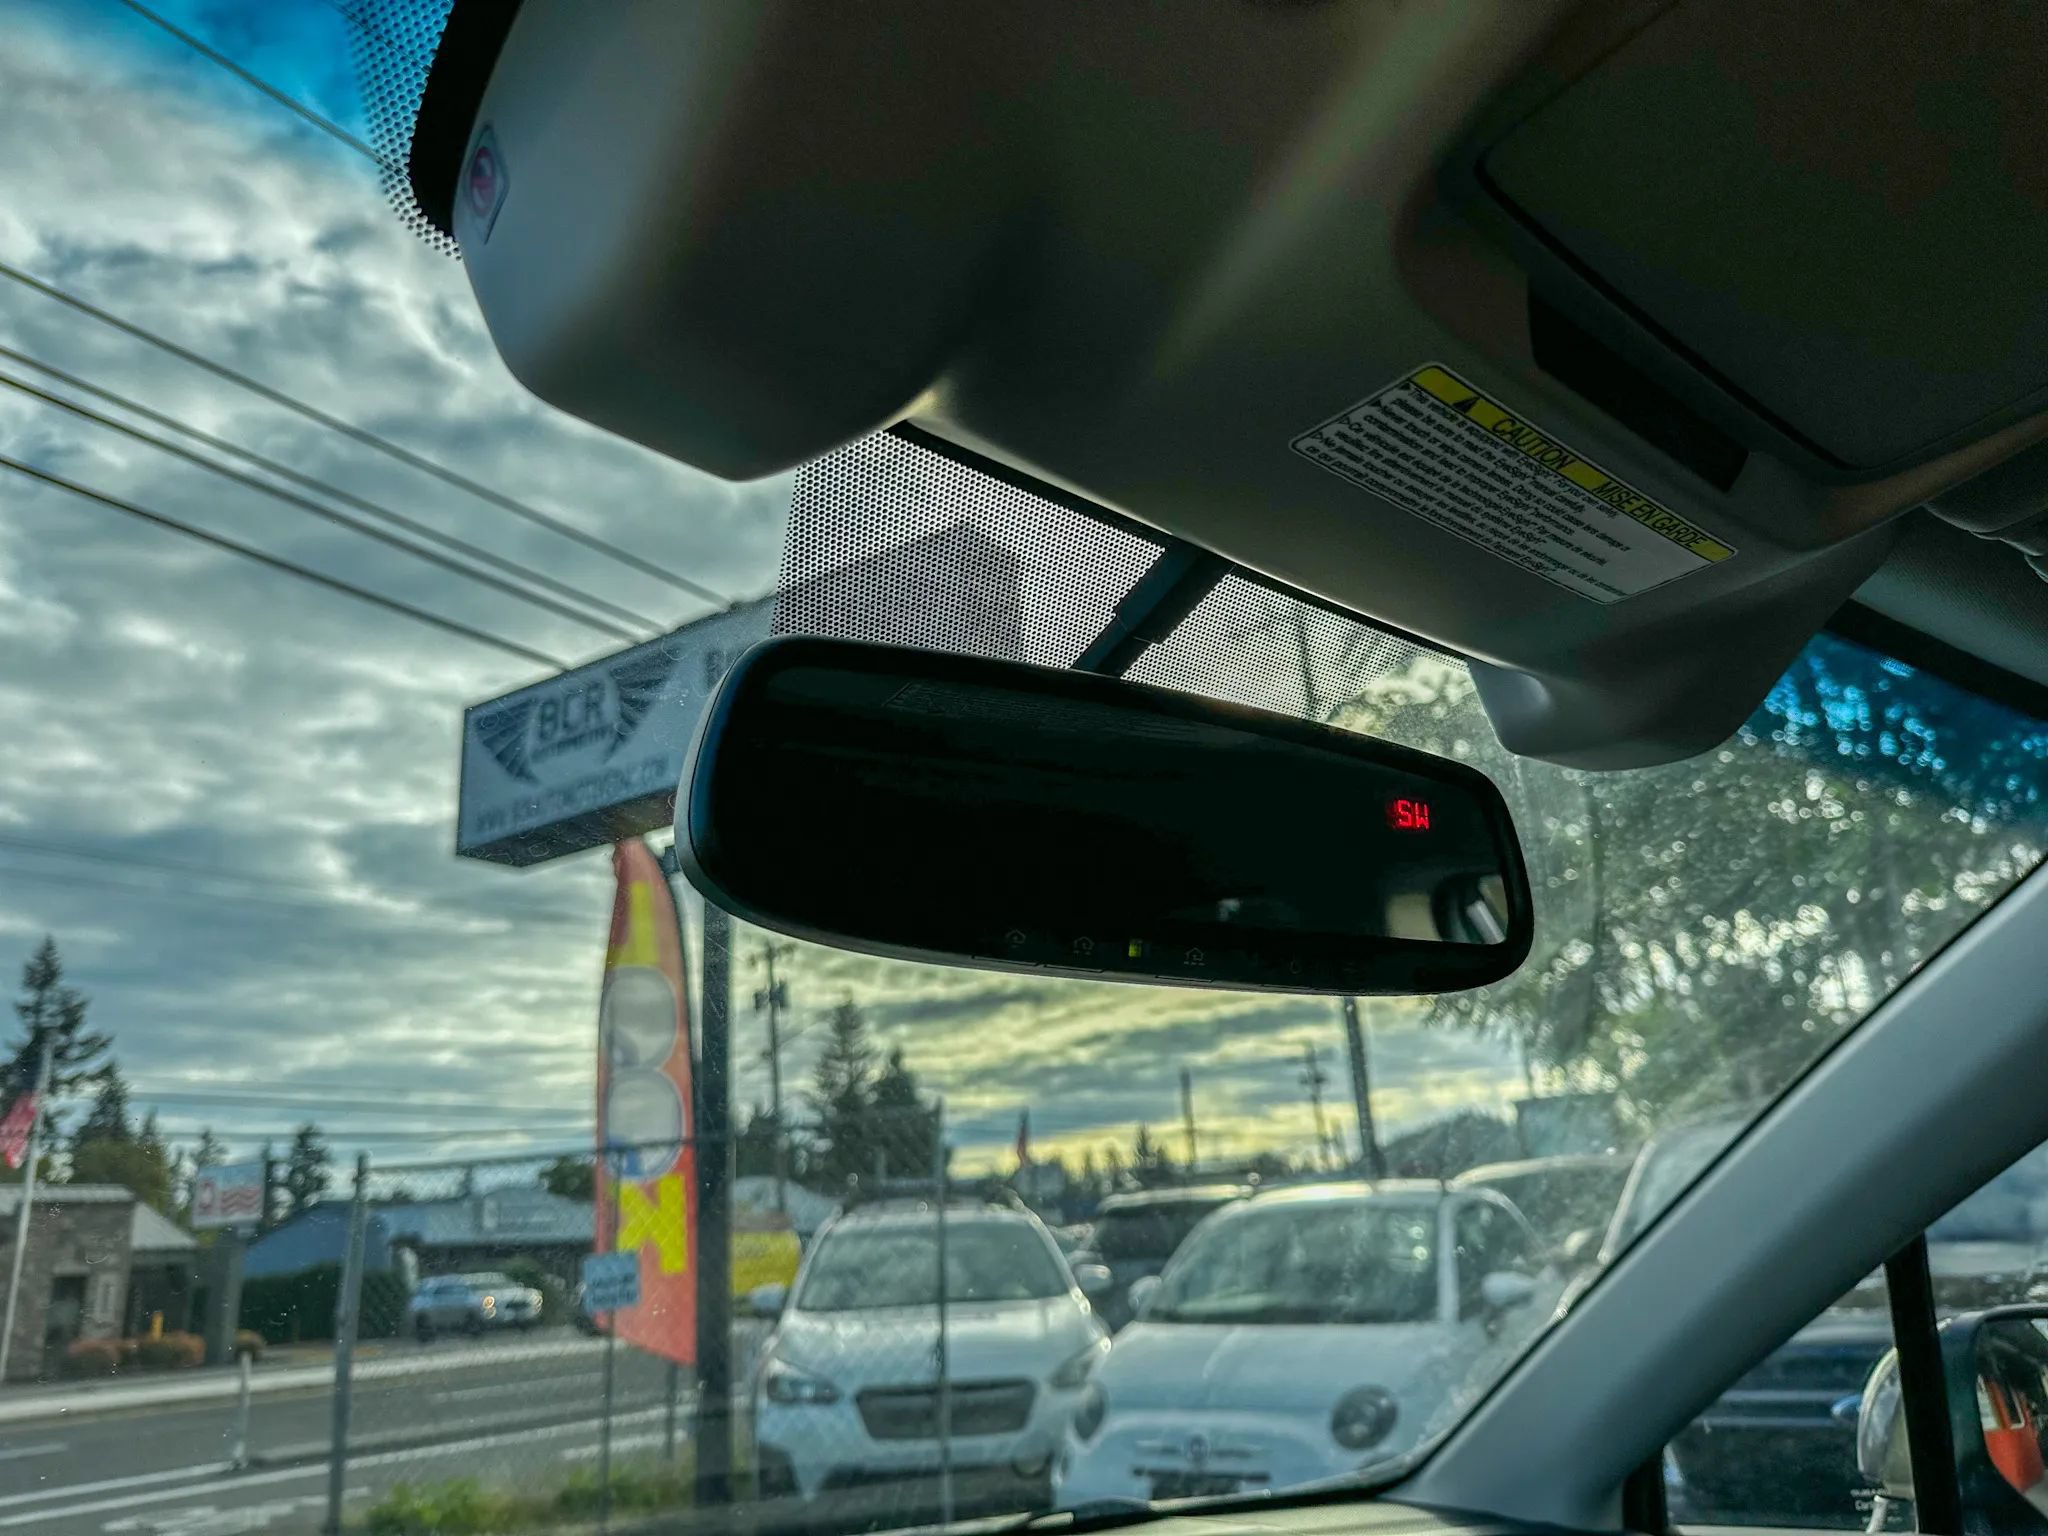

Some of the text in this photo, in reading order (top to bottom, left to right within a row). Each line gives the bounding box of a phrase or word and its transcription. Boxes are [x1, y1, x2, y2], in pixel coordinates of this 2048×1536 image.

[1487, 416, 1578, 470] CAUTION
[1590, 480, 1708, 548] MISE EN GARDE
[1396, 799, 1430, 830] SW
